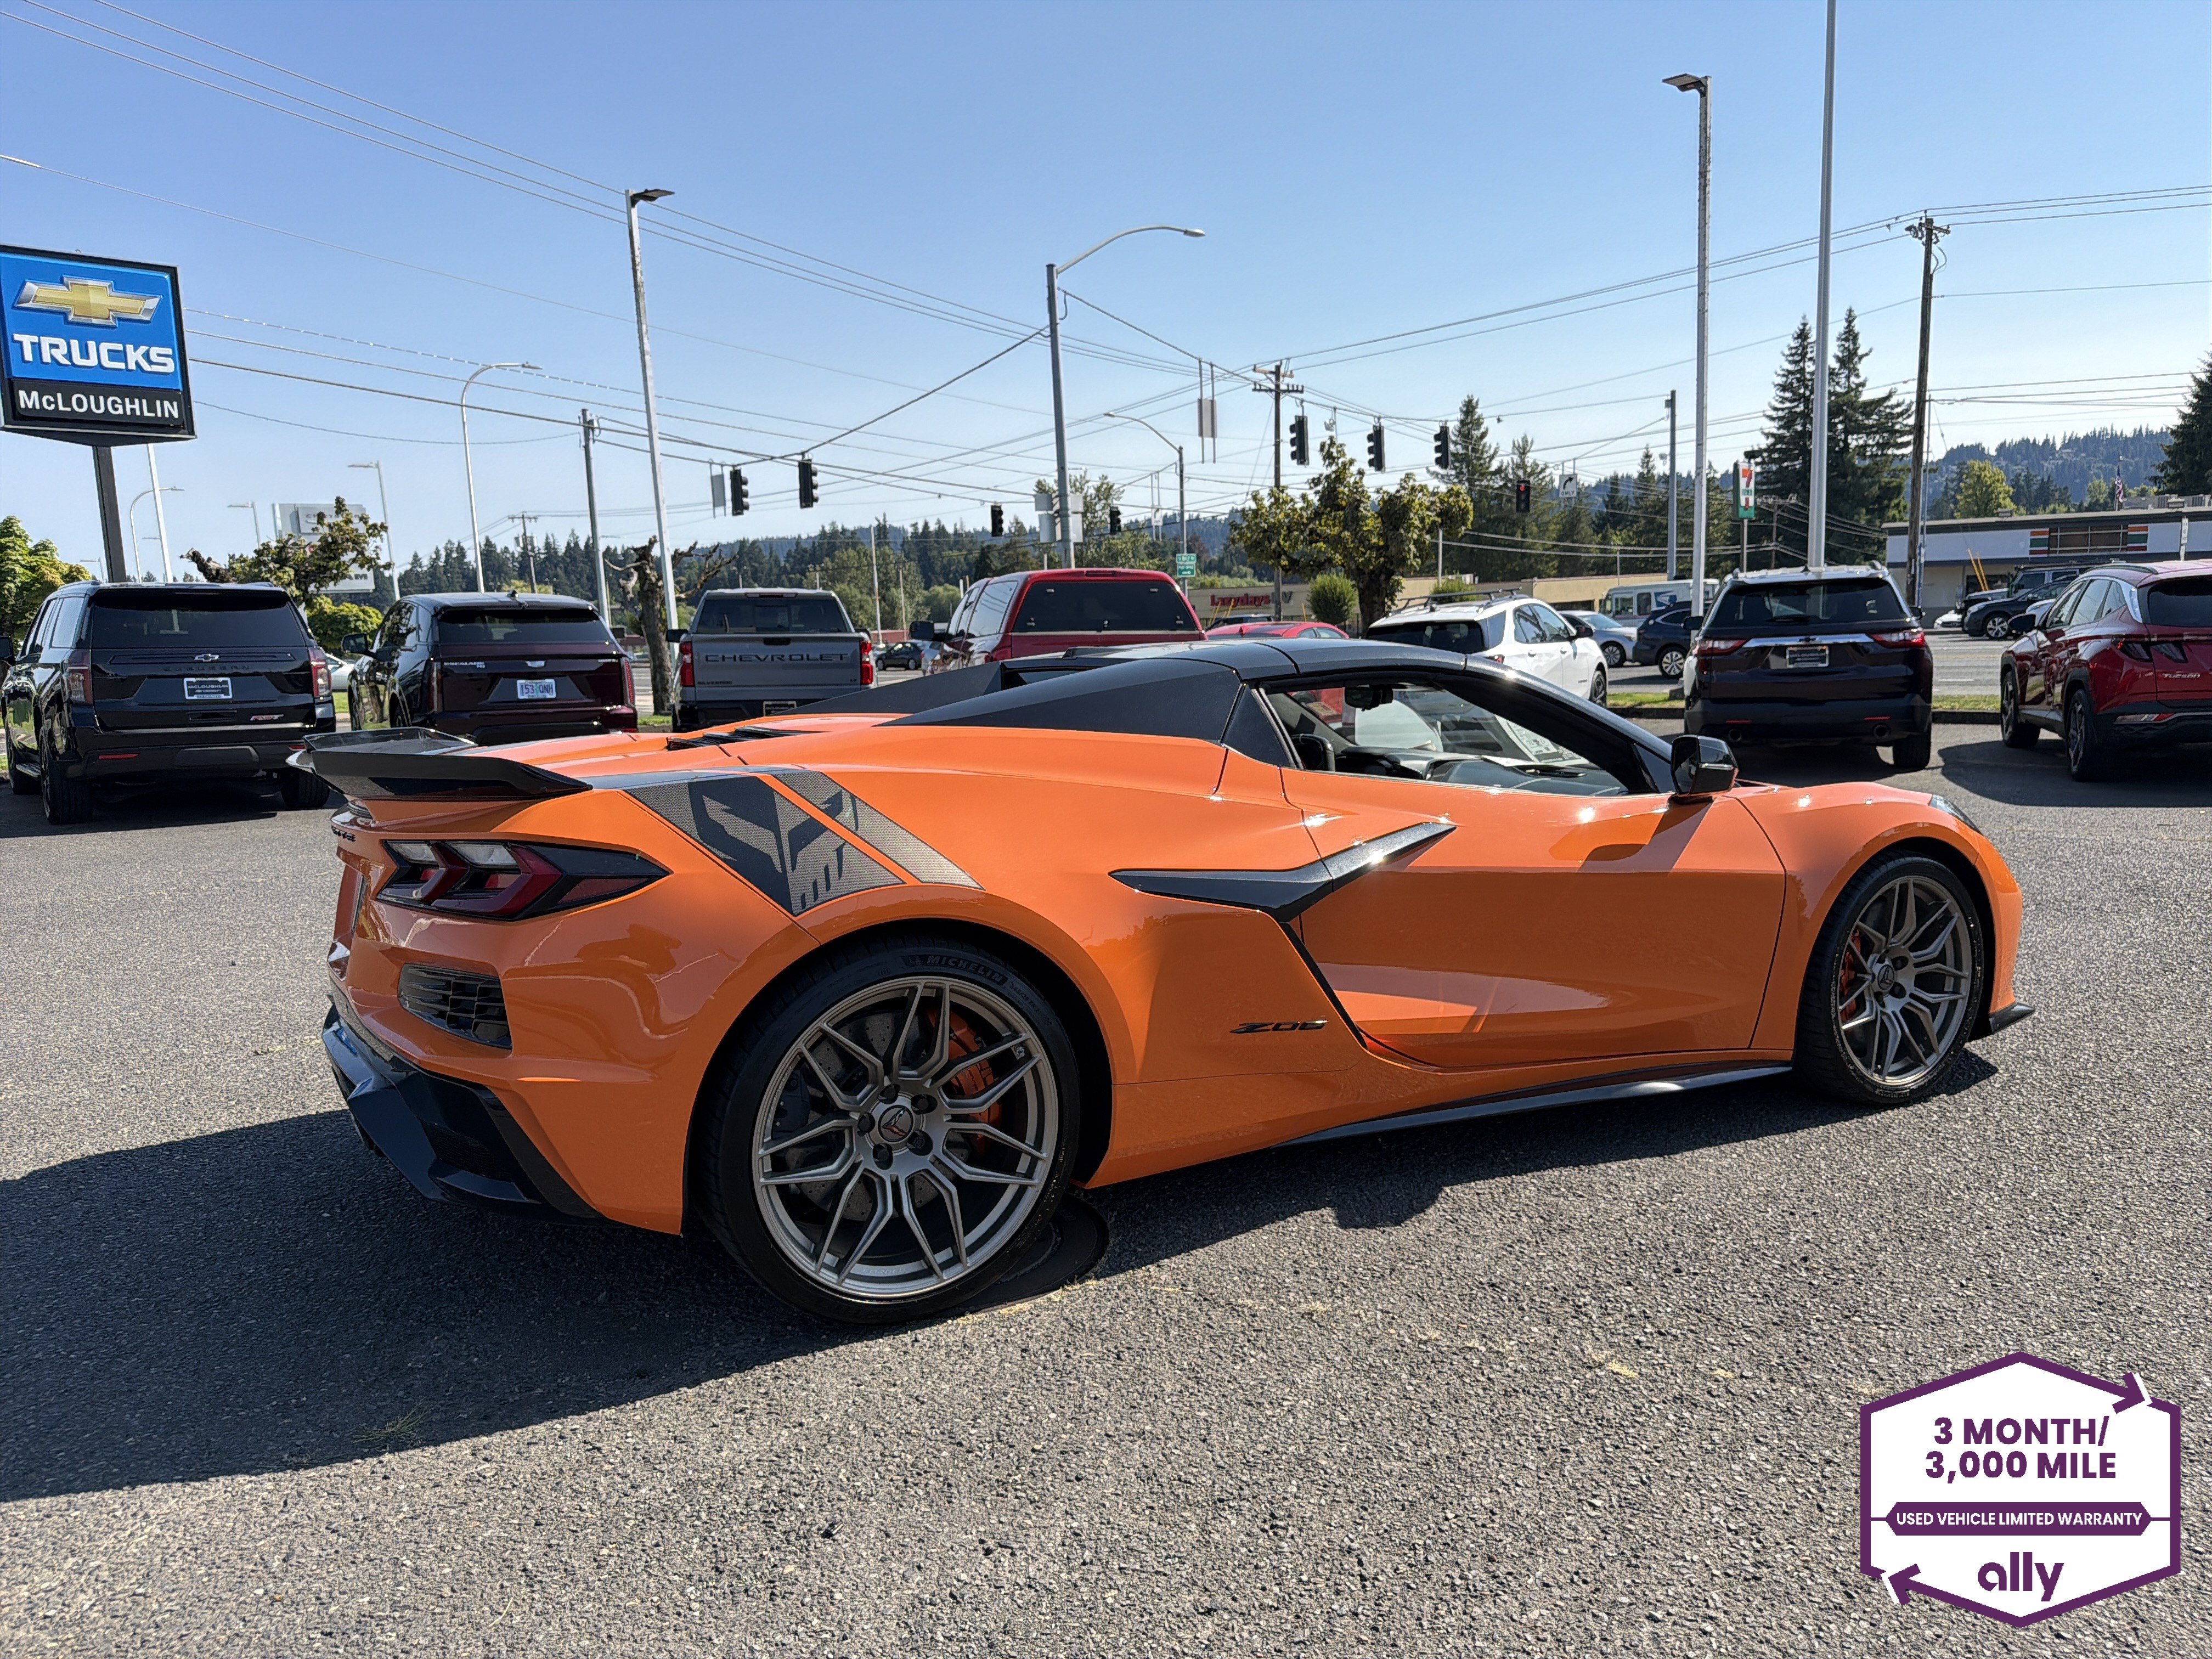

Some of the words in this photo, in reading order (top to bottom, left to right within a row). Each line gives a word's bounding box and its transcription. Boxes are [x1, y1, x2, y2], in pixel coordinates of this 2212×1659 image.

[13, 334, 174, 373] TRUCKS
[18, 390, 179, 418] McLOUGHLIN
[1210, 593, 1271, 607] Lazydays
[705, 653, 849, 662] CHEVROLET
[926, 955, 1005, 983] MICHELIN
[1229, 1019, 1328, 1034] Z06
